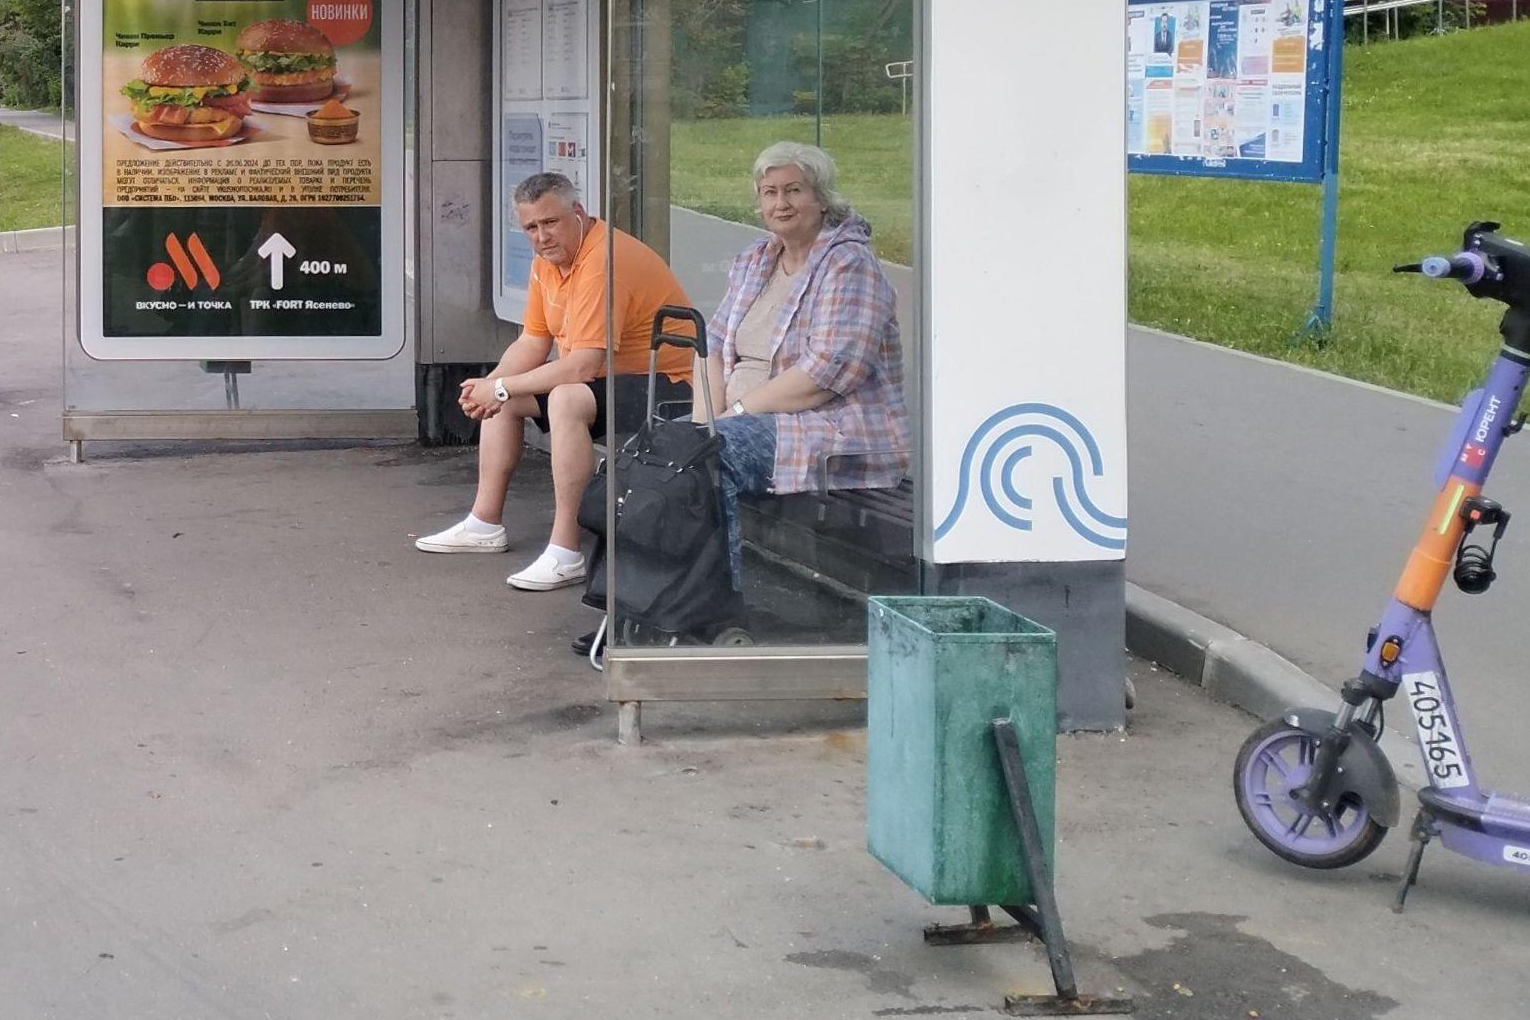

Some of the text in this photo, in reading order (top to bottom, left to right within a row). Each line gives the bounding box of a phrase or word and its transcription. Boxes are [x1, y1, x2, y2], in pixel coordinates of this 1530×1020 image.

[311, 4, 368, 20] НОВИНКИ
[299, 260, 347, 275] 400 м
[135, 300, 177, 310] ВКУСНО
[187, 300, 196, 310] И
[197, 300, 232, 310] ТОЧКА
[250, 300, 270, 310] ТРК
[1475, 394, 1502, 443] ЮРЕНТ
[1410, 681, 1462, 779] 405165
[1511, 850, 1530, 861] 40
